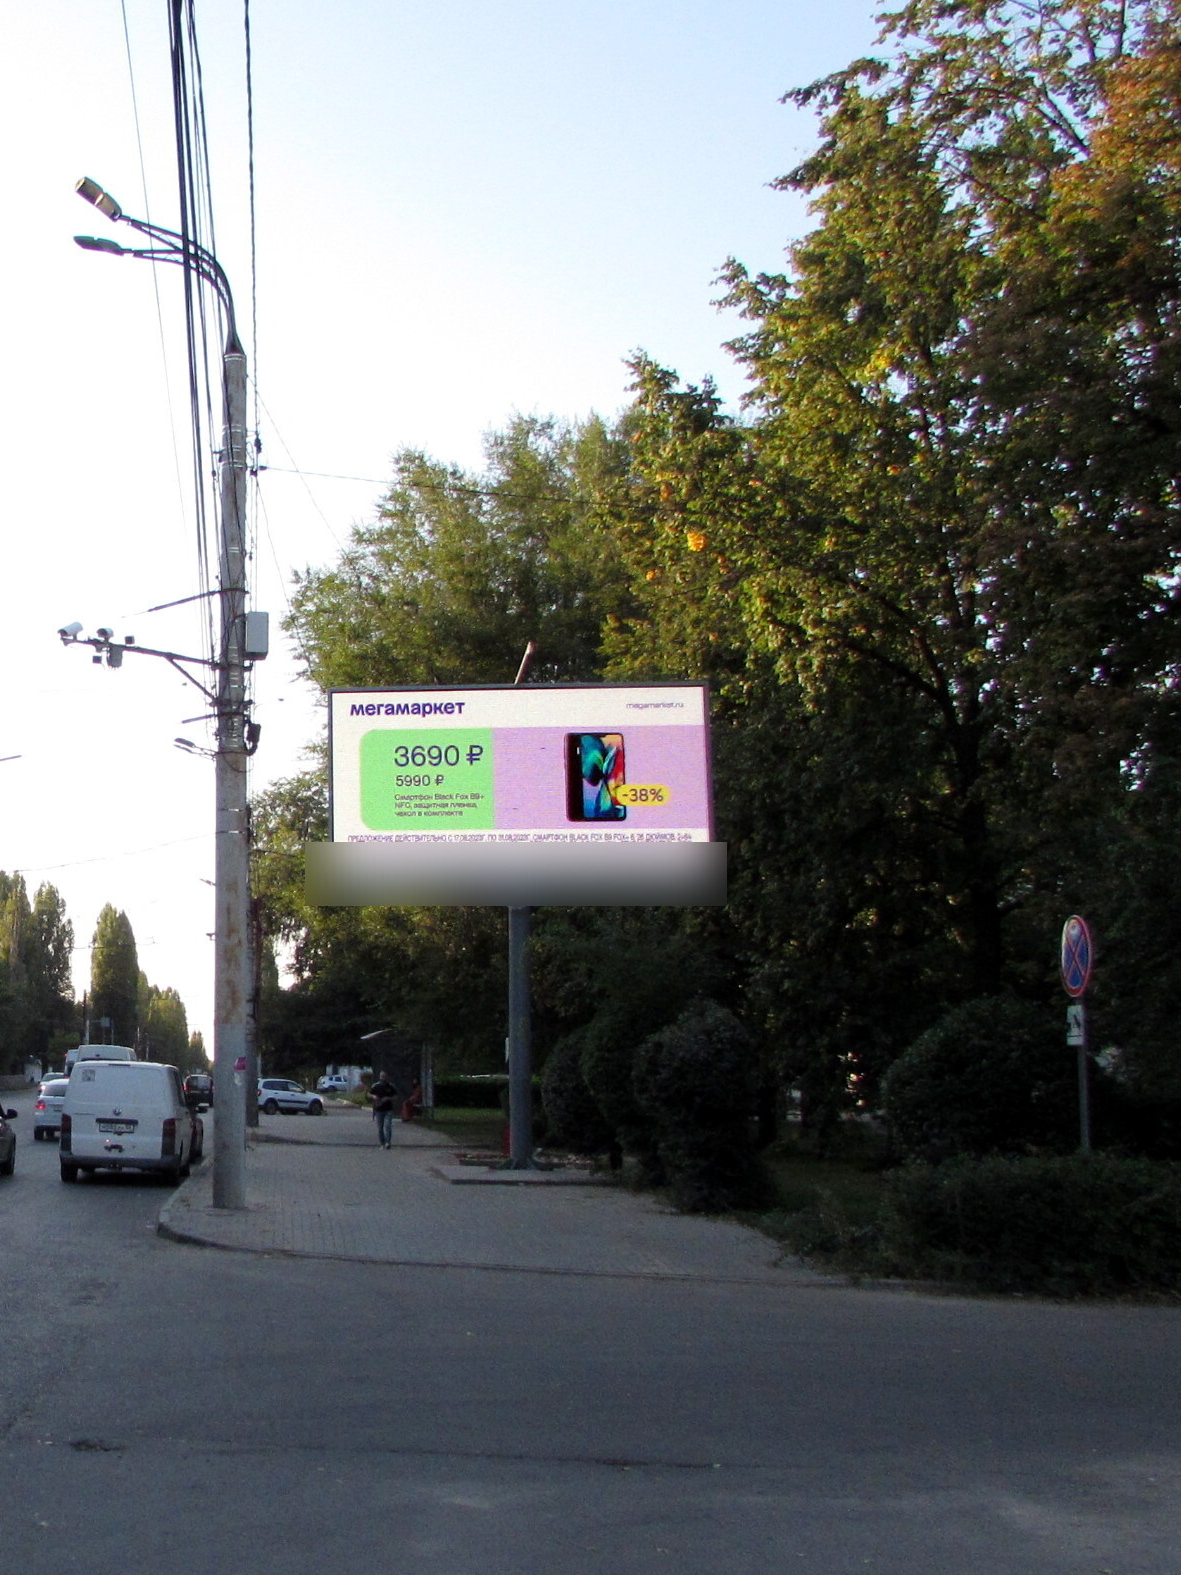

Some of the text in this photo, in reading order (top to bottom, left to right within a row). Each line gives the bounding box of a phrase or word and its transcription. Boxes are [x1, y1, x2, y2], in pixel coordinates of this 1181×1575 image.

[350, 702, 465, 717] мегамаркет
[394, 744, 484, 767] 3690 ₽
[395, 774, 445, 787] 5990 ₽
[622, 788, 665, 803] -38%
